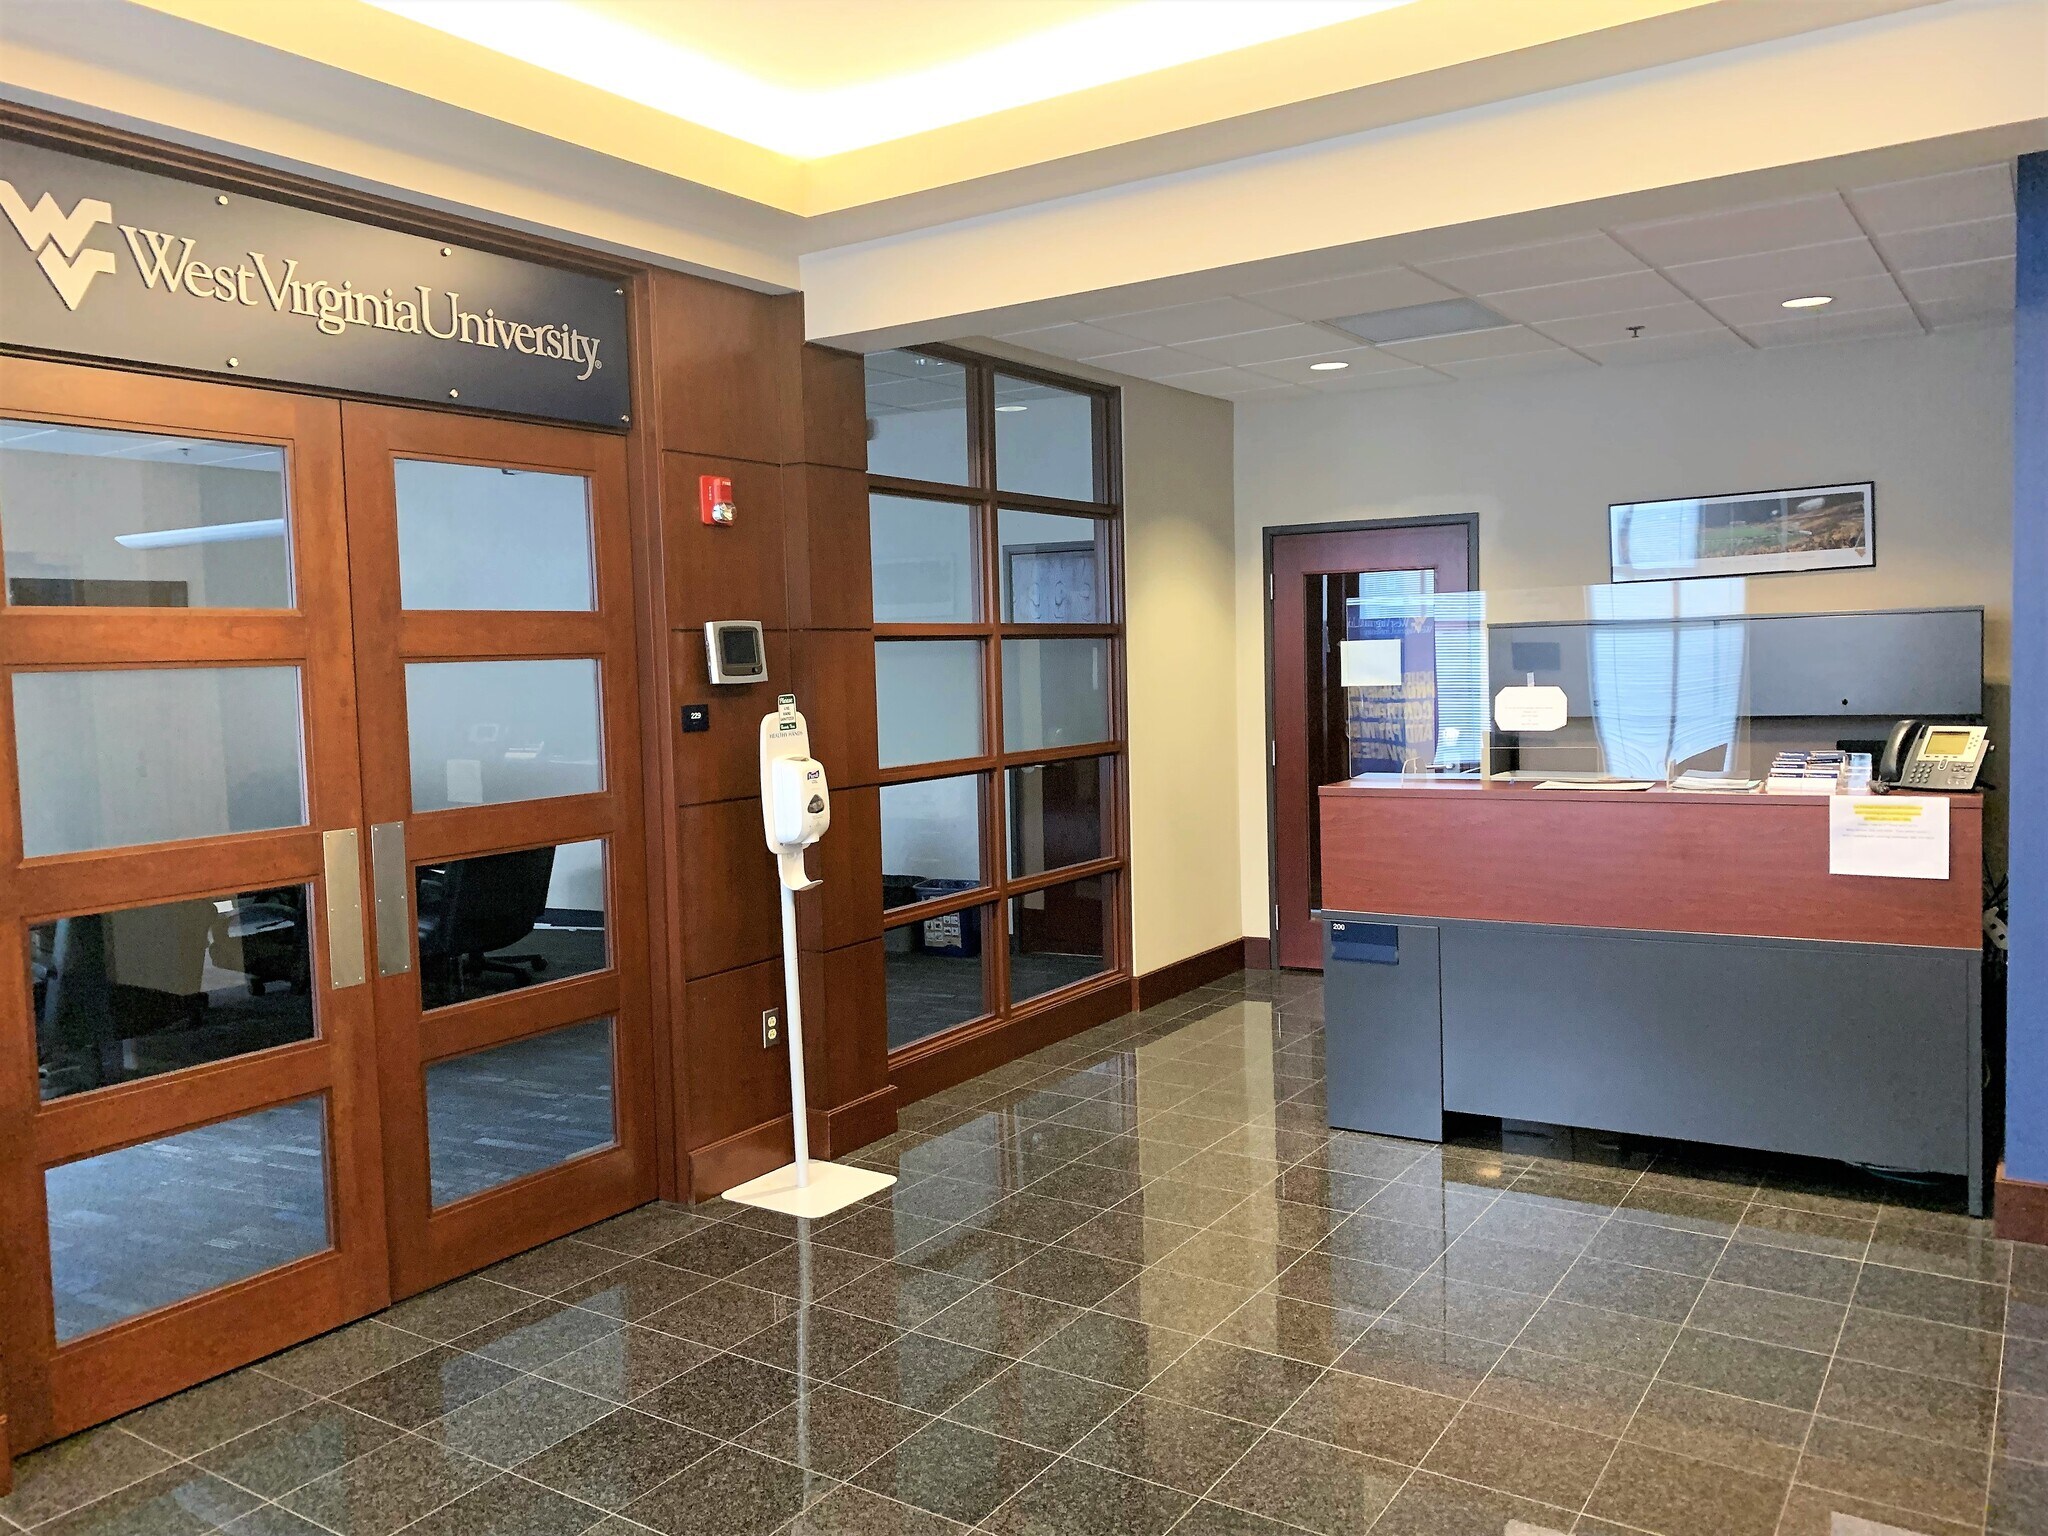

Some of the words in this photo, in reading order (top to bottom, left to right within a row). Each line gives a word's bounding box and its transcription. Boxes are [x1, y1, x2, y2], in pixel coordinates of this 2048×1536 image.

[117, 224, 258, 306] West
[247, 251, 422, 335] Virginia
[415, 285, 600, 381] University
